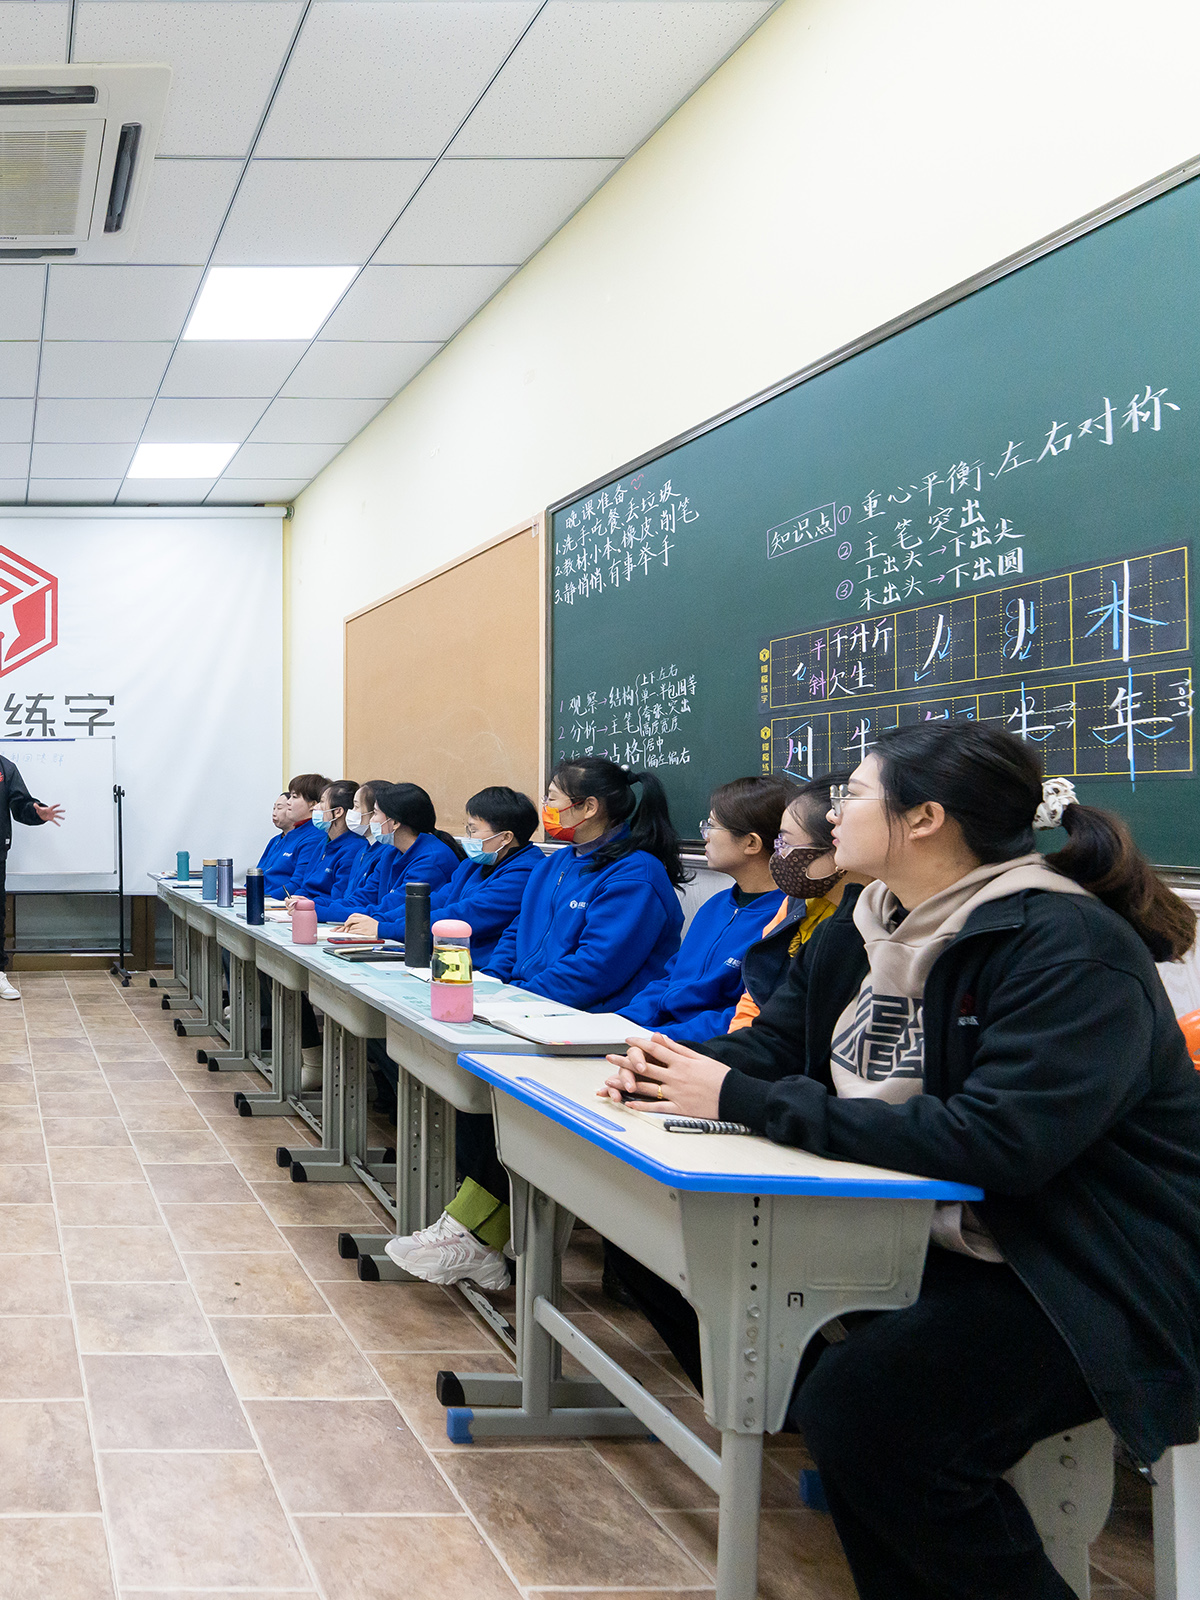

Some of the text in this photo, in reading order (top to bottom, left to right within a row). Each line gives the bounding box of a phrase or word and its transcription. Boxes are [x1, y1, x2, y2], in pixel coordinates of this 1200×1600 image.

[565, 483, 628, 529] 晚课准备
[770, 512, 834, 556] 知识点
[855, 499, 986, 565] 主笔突出
[858, 551, 923, 584] 上出头
[946, 547, 1023, 588] 下出圆
[568, 690, 599, 717] 观察
[608, 686, 634, 709] 结构
[570, 720, 597, 744] 分析
[608, 711, 640, 736] 主笔
[642, 715, 682, 737] 高度宽度
[609, 738, 644, 765] 占格
[646, 736, 664, 753] 居中
[647, 747, 690, 769] 偏左偏右
